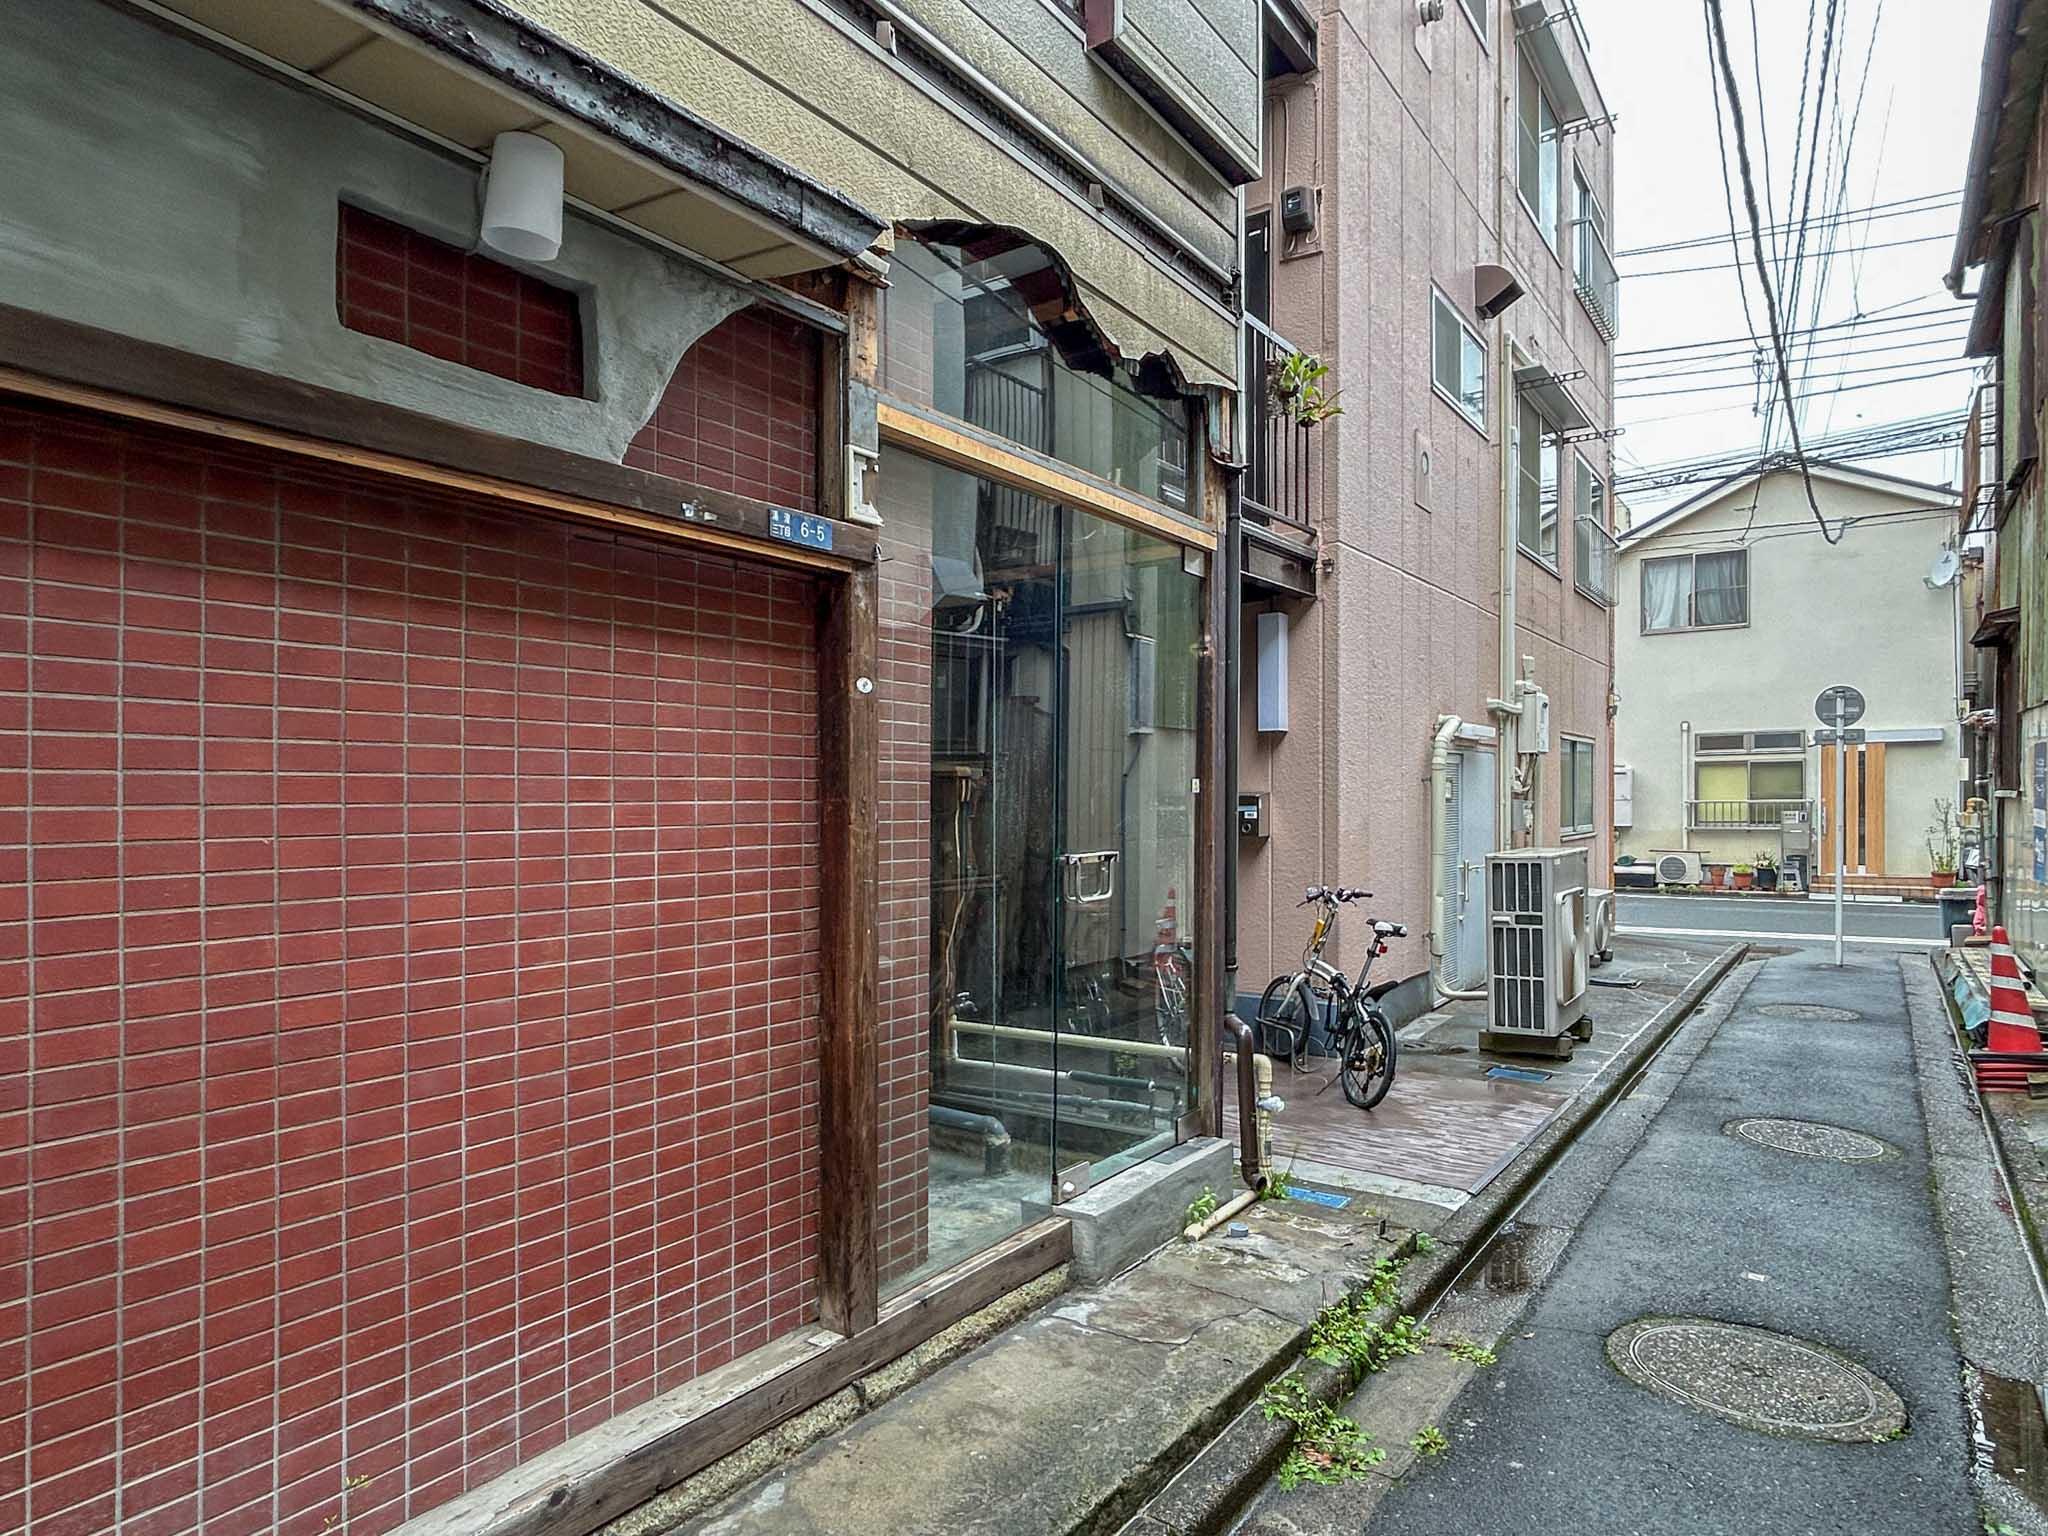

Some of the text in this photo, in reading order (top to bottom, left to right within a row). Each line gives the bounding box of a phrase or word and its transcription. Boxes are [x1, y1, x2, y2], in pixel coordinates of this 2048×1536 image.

[772, 523, 790, 538] 三丁目
[800, 521, 825, 542] 6-5
